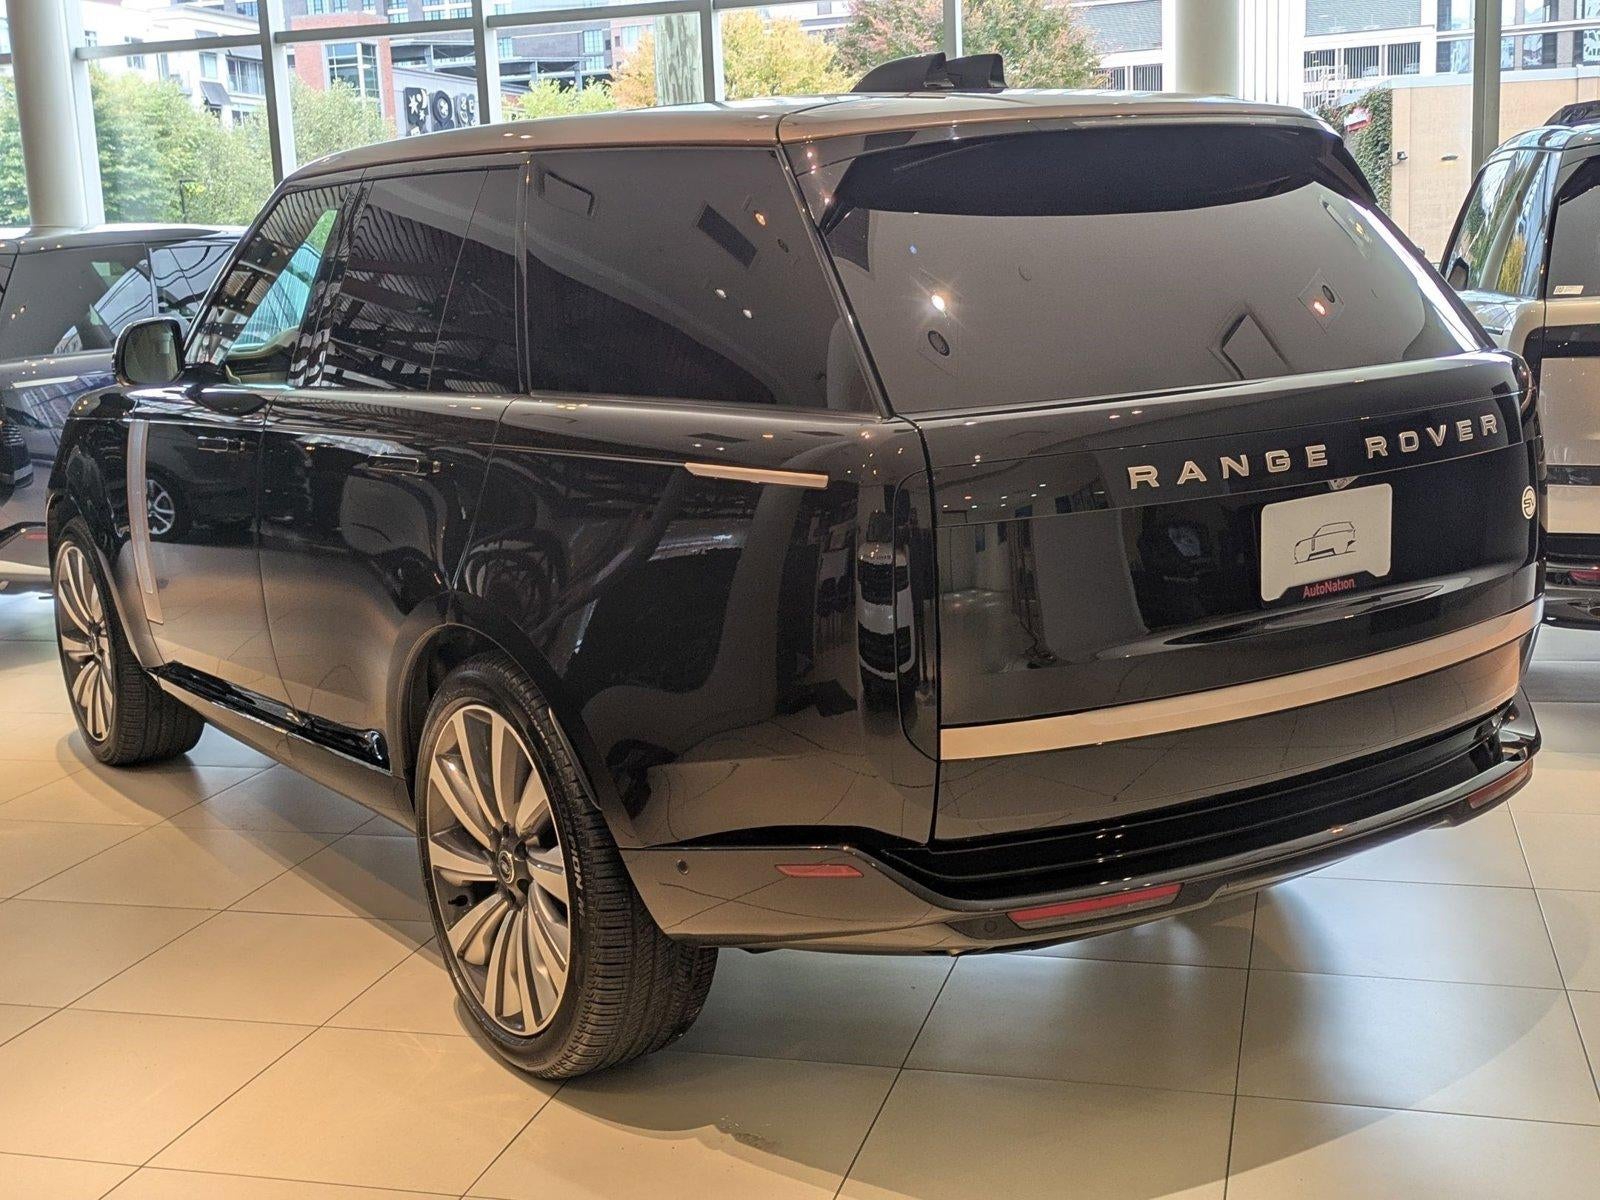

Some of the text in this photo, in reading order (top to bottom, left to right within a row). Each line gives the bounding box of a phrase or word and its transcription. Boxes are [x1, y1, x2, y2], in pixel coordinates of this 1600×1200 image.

[1127, 413, 1498, 490] RANGE ROVER
[1303, 578, 1355, 599] AutoNation
